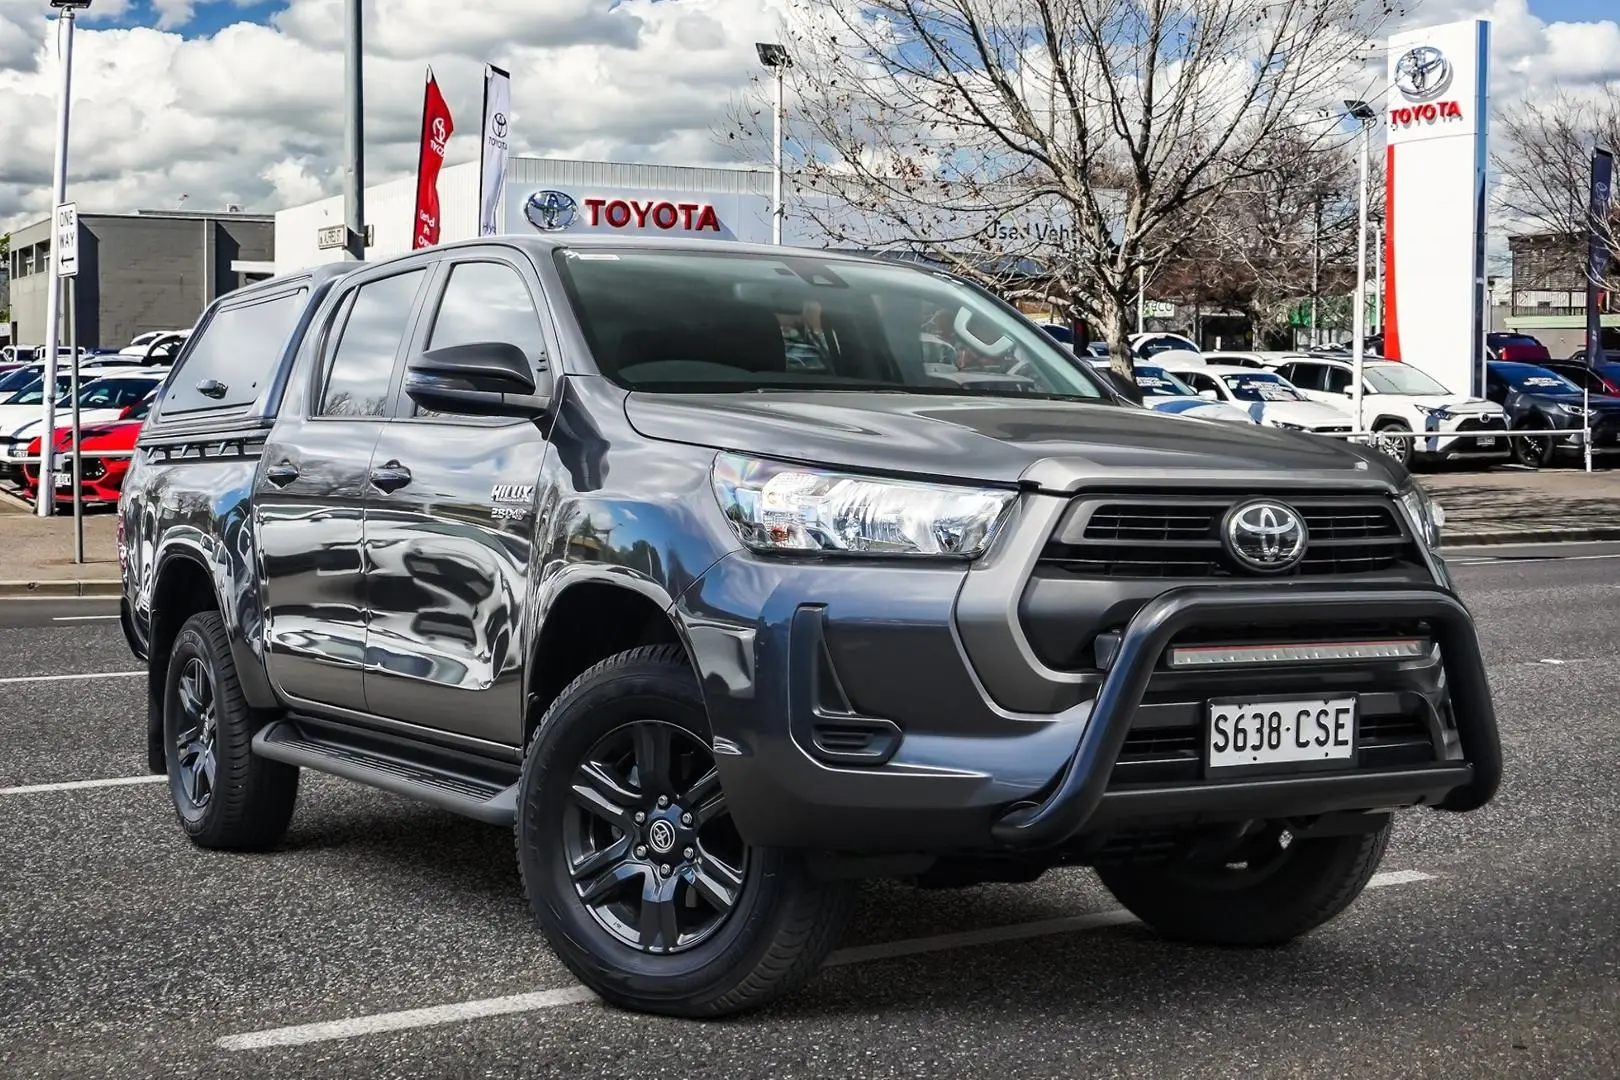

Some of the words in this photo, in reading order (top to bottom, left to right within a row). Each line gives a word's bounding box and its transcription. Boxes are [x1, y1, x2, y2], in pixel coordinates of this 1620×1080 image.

[1390, 101, 1461, 124] TOYOTA
[60, 210, 73, 227] ONE
[584, 199, 720, 232] TOYOTA
[986, 220, 1030, 239] Used
[60, 232, 75, 248] WAY
[490, 484, 534, 503] HILUX
